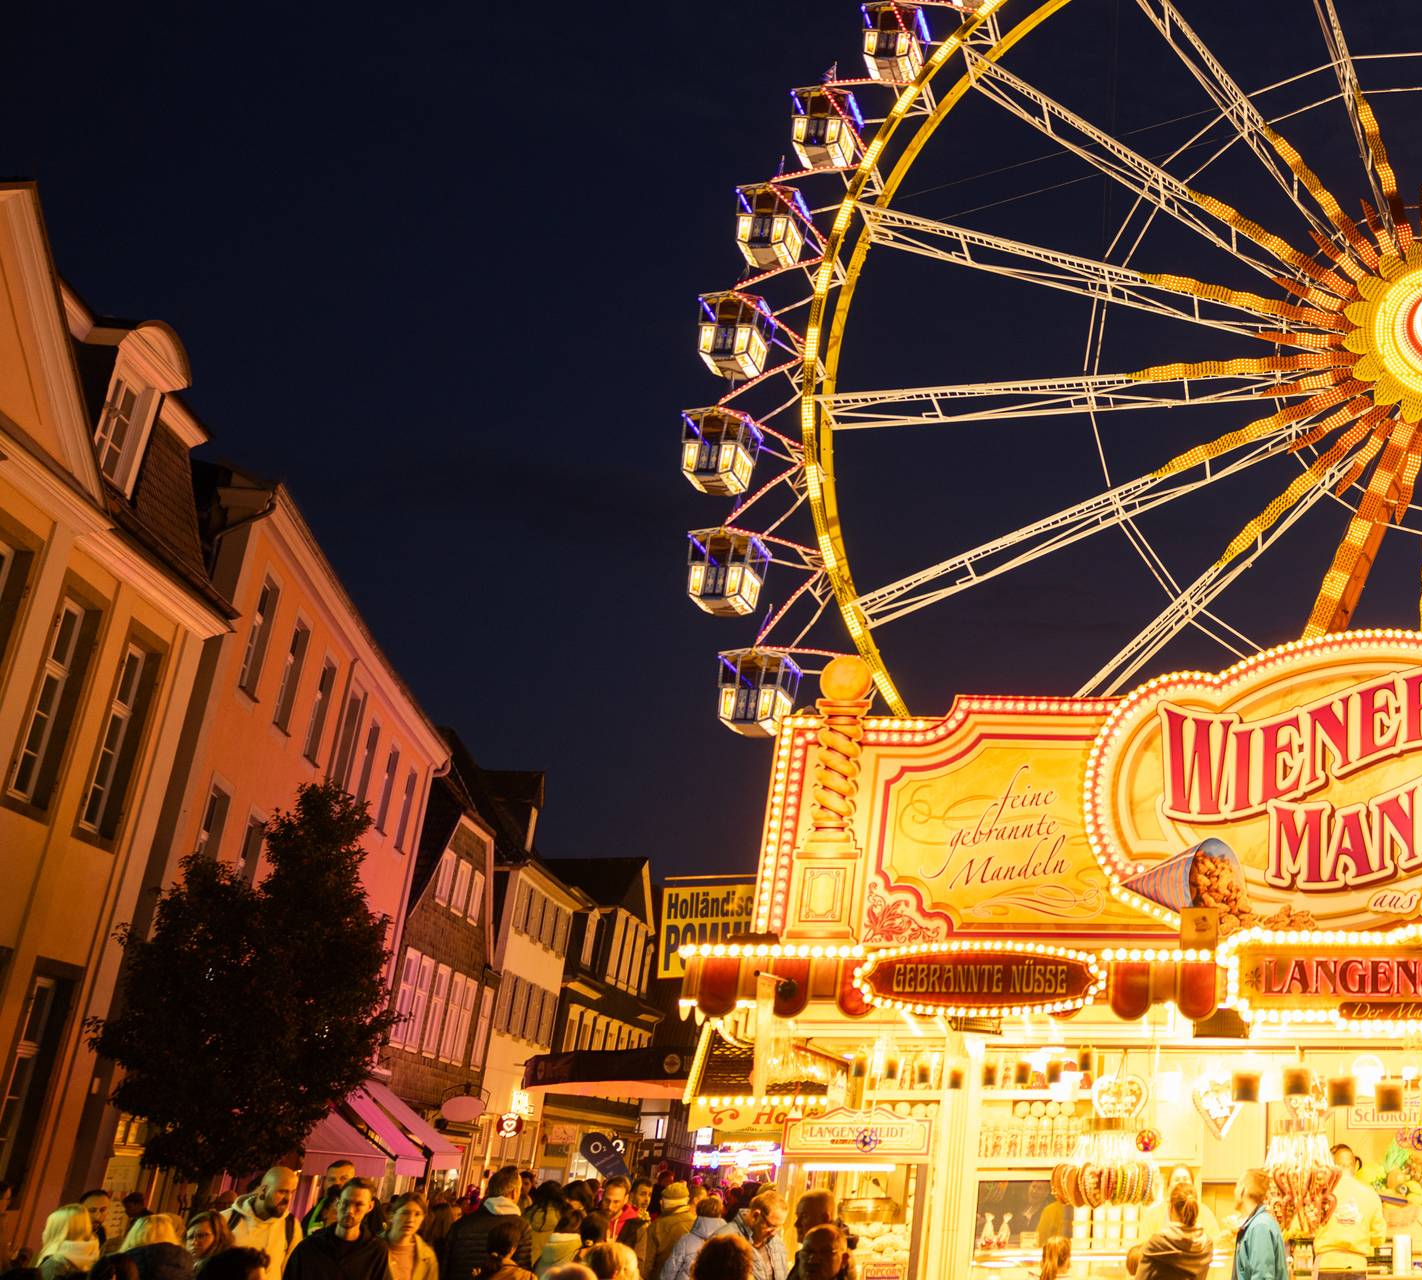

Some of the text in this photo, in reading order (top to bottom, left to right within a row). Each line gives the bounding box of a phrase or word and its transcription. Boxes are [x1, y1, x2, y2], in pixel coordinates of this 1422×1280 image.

[988, 765, 1057, 834] feine
[926, 803, 1058, 876] gebrannte
[949, 835, 1067, 890] Mandeln
[1373, 892, 1416, 910] aus
[892, 960, 1068, 994] GEBRANNTE NÜSSE
[1351, 1002, 1384, 1019] Der
